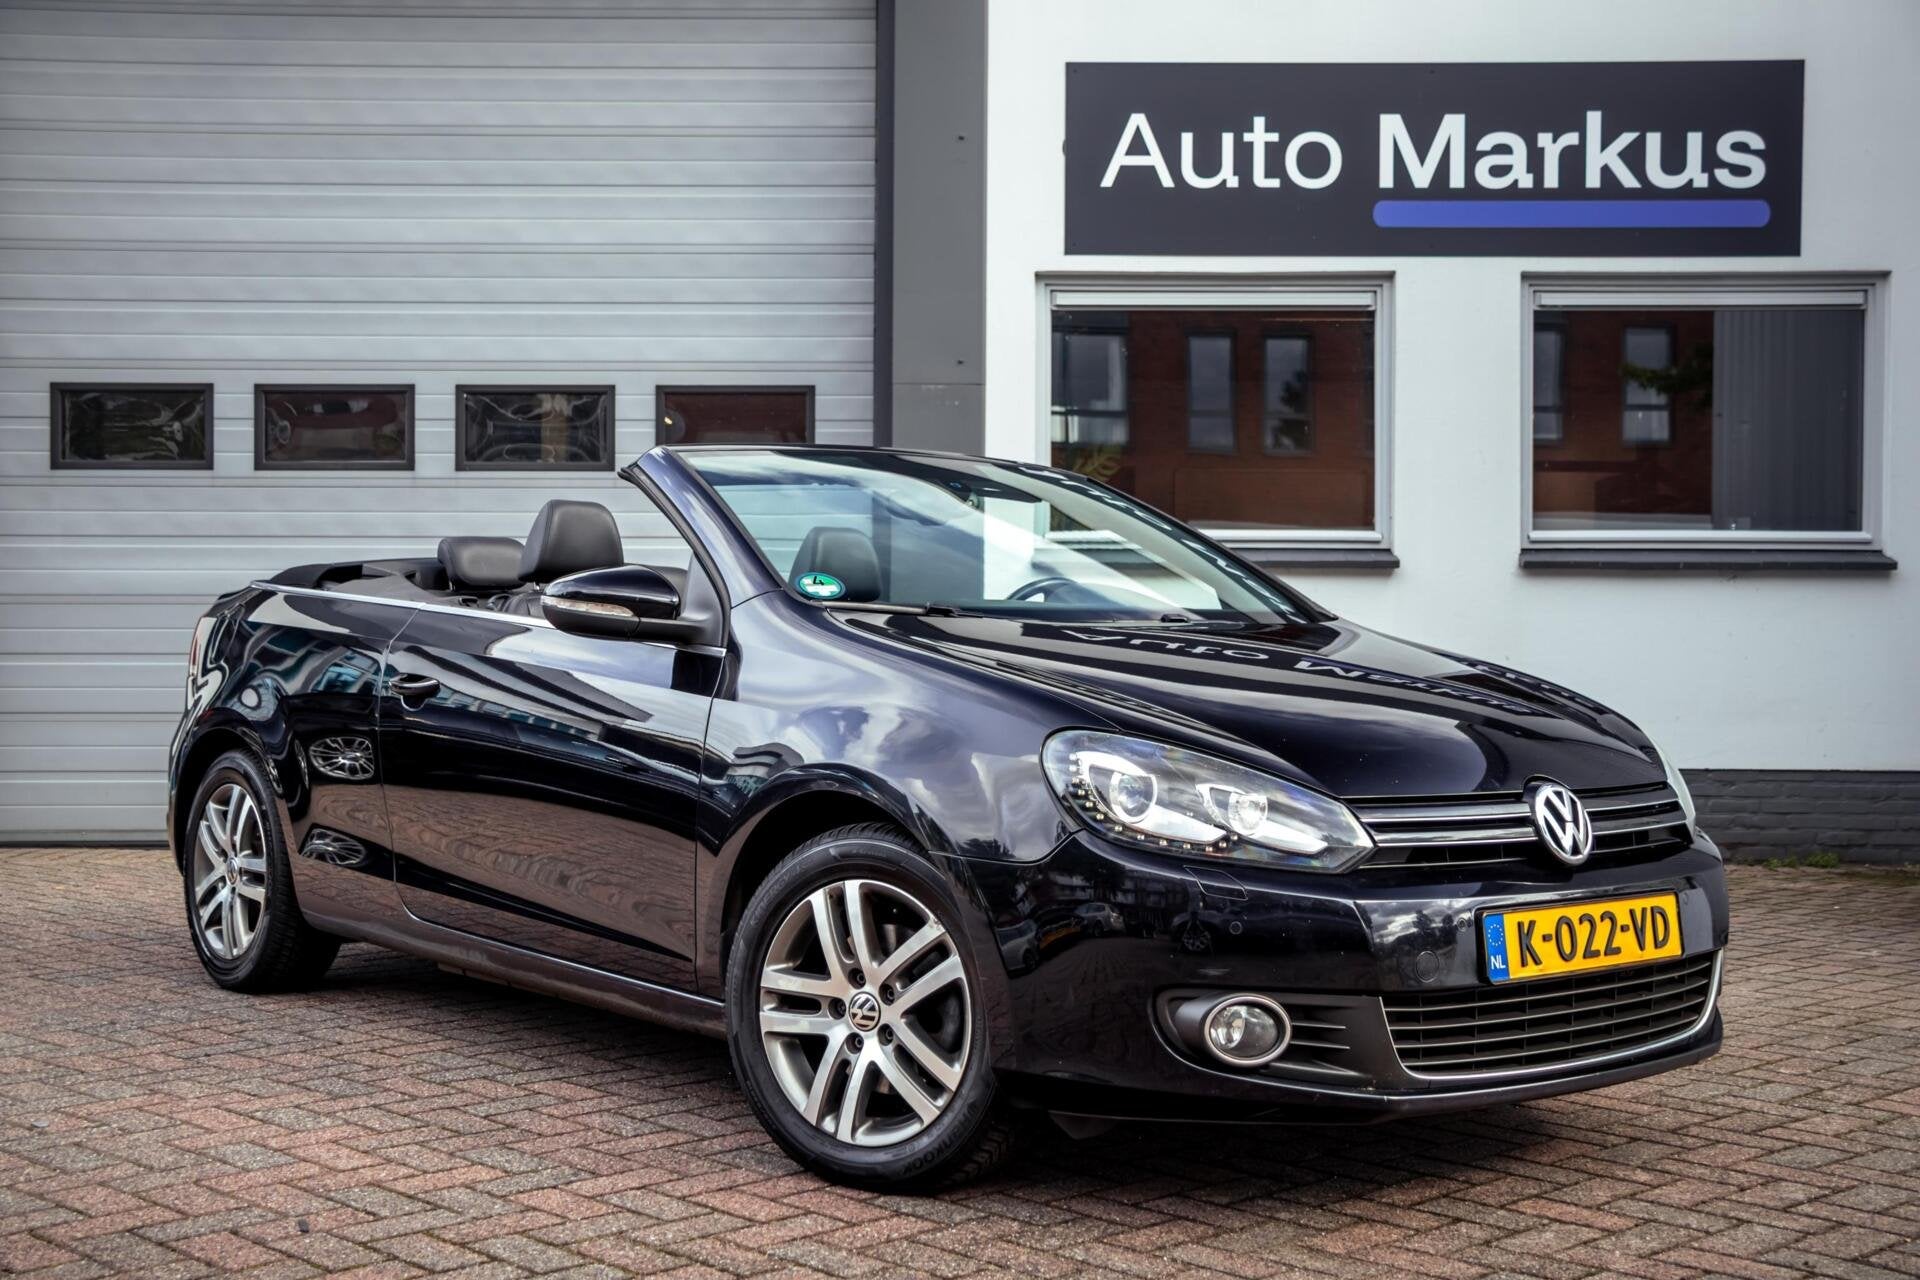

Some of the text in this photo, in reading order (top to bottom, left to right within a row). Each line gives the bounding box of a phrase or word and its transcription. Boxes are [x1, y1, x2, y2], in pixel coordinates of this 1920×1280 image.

[1100, 110, 1767, 189] Auto Markus
[1535, 784, 1593, 865] VW
[1490, 955, 1506, 970] NL
[1517, 905, 1671, 968] K-022-VD
